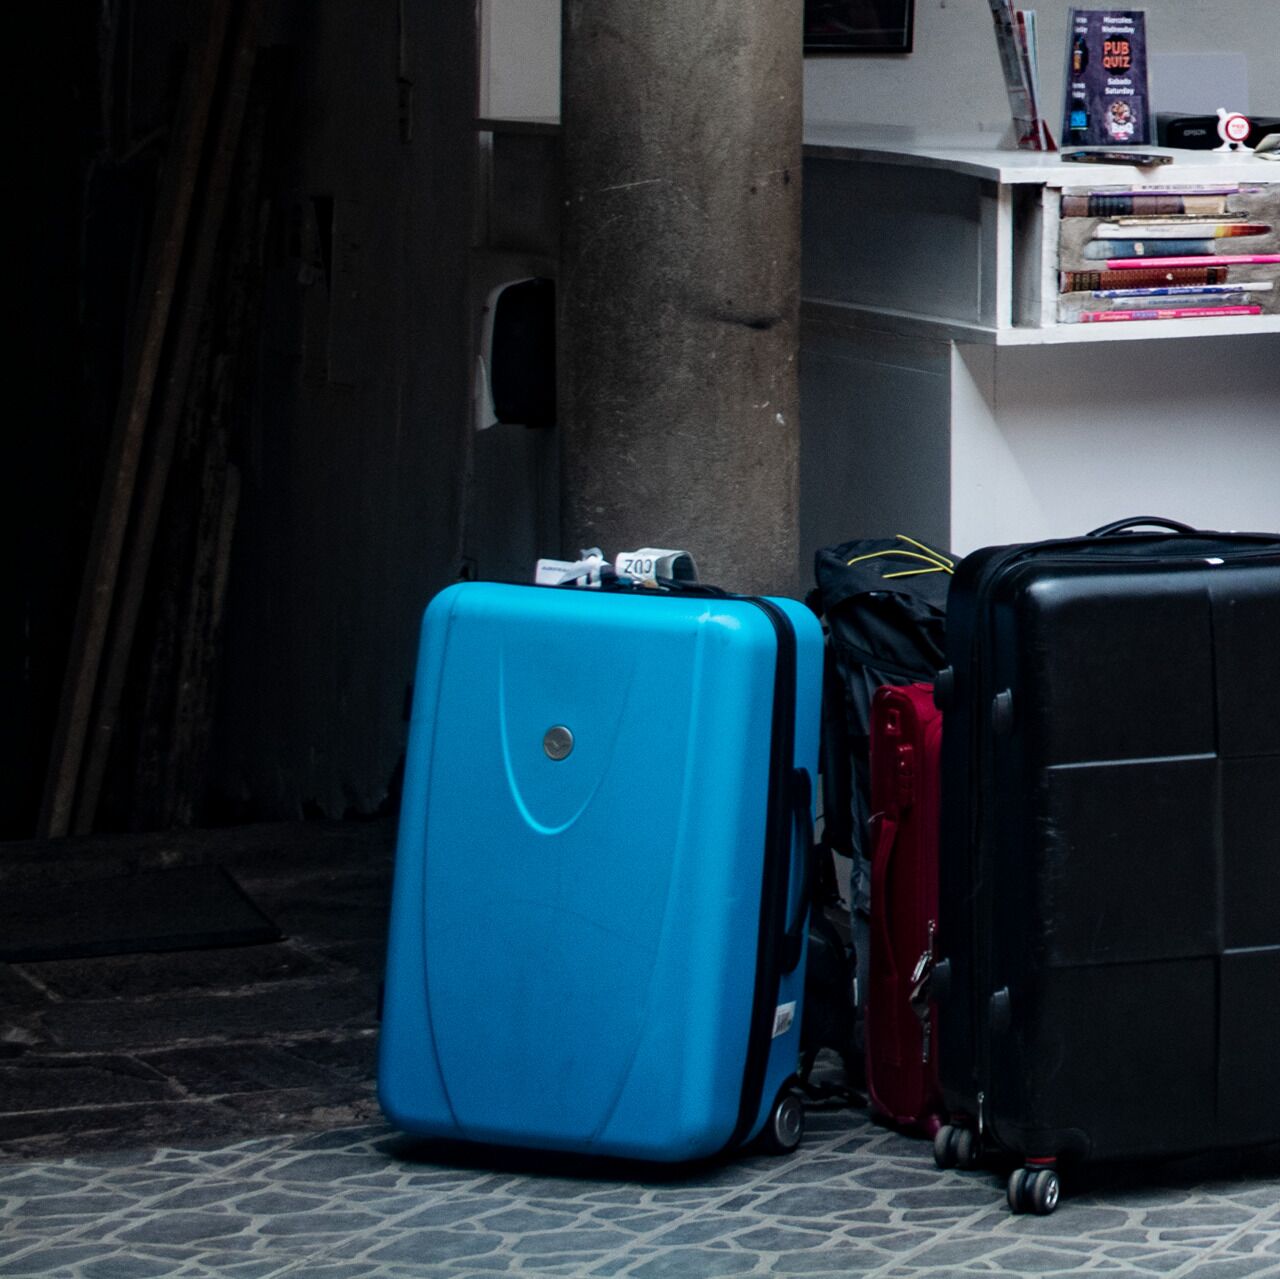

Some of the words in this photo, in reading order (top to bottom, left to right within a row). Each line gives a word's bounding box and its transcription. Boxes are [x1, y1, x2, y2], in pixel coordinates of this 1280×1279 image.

[1103, 41, 1130, 55] PUB
[1103, 56, 1131, 69] QUIZ
[625, 559, 654, 575] CUZ
